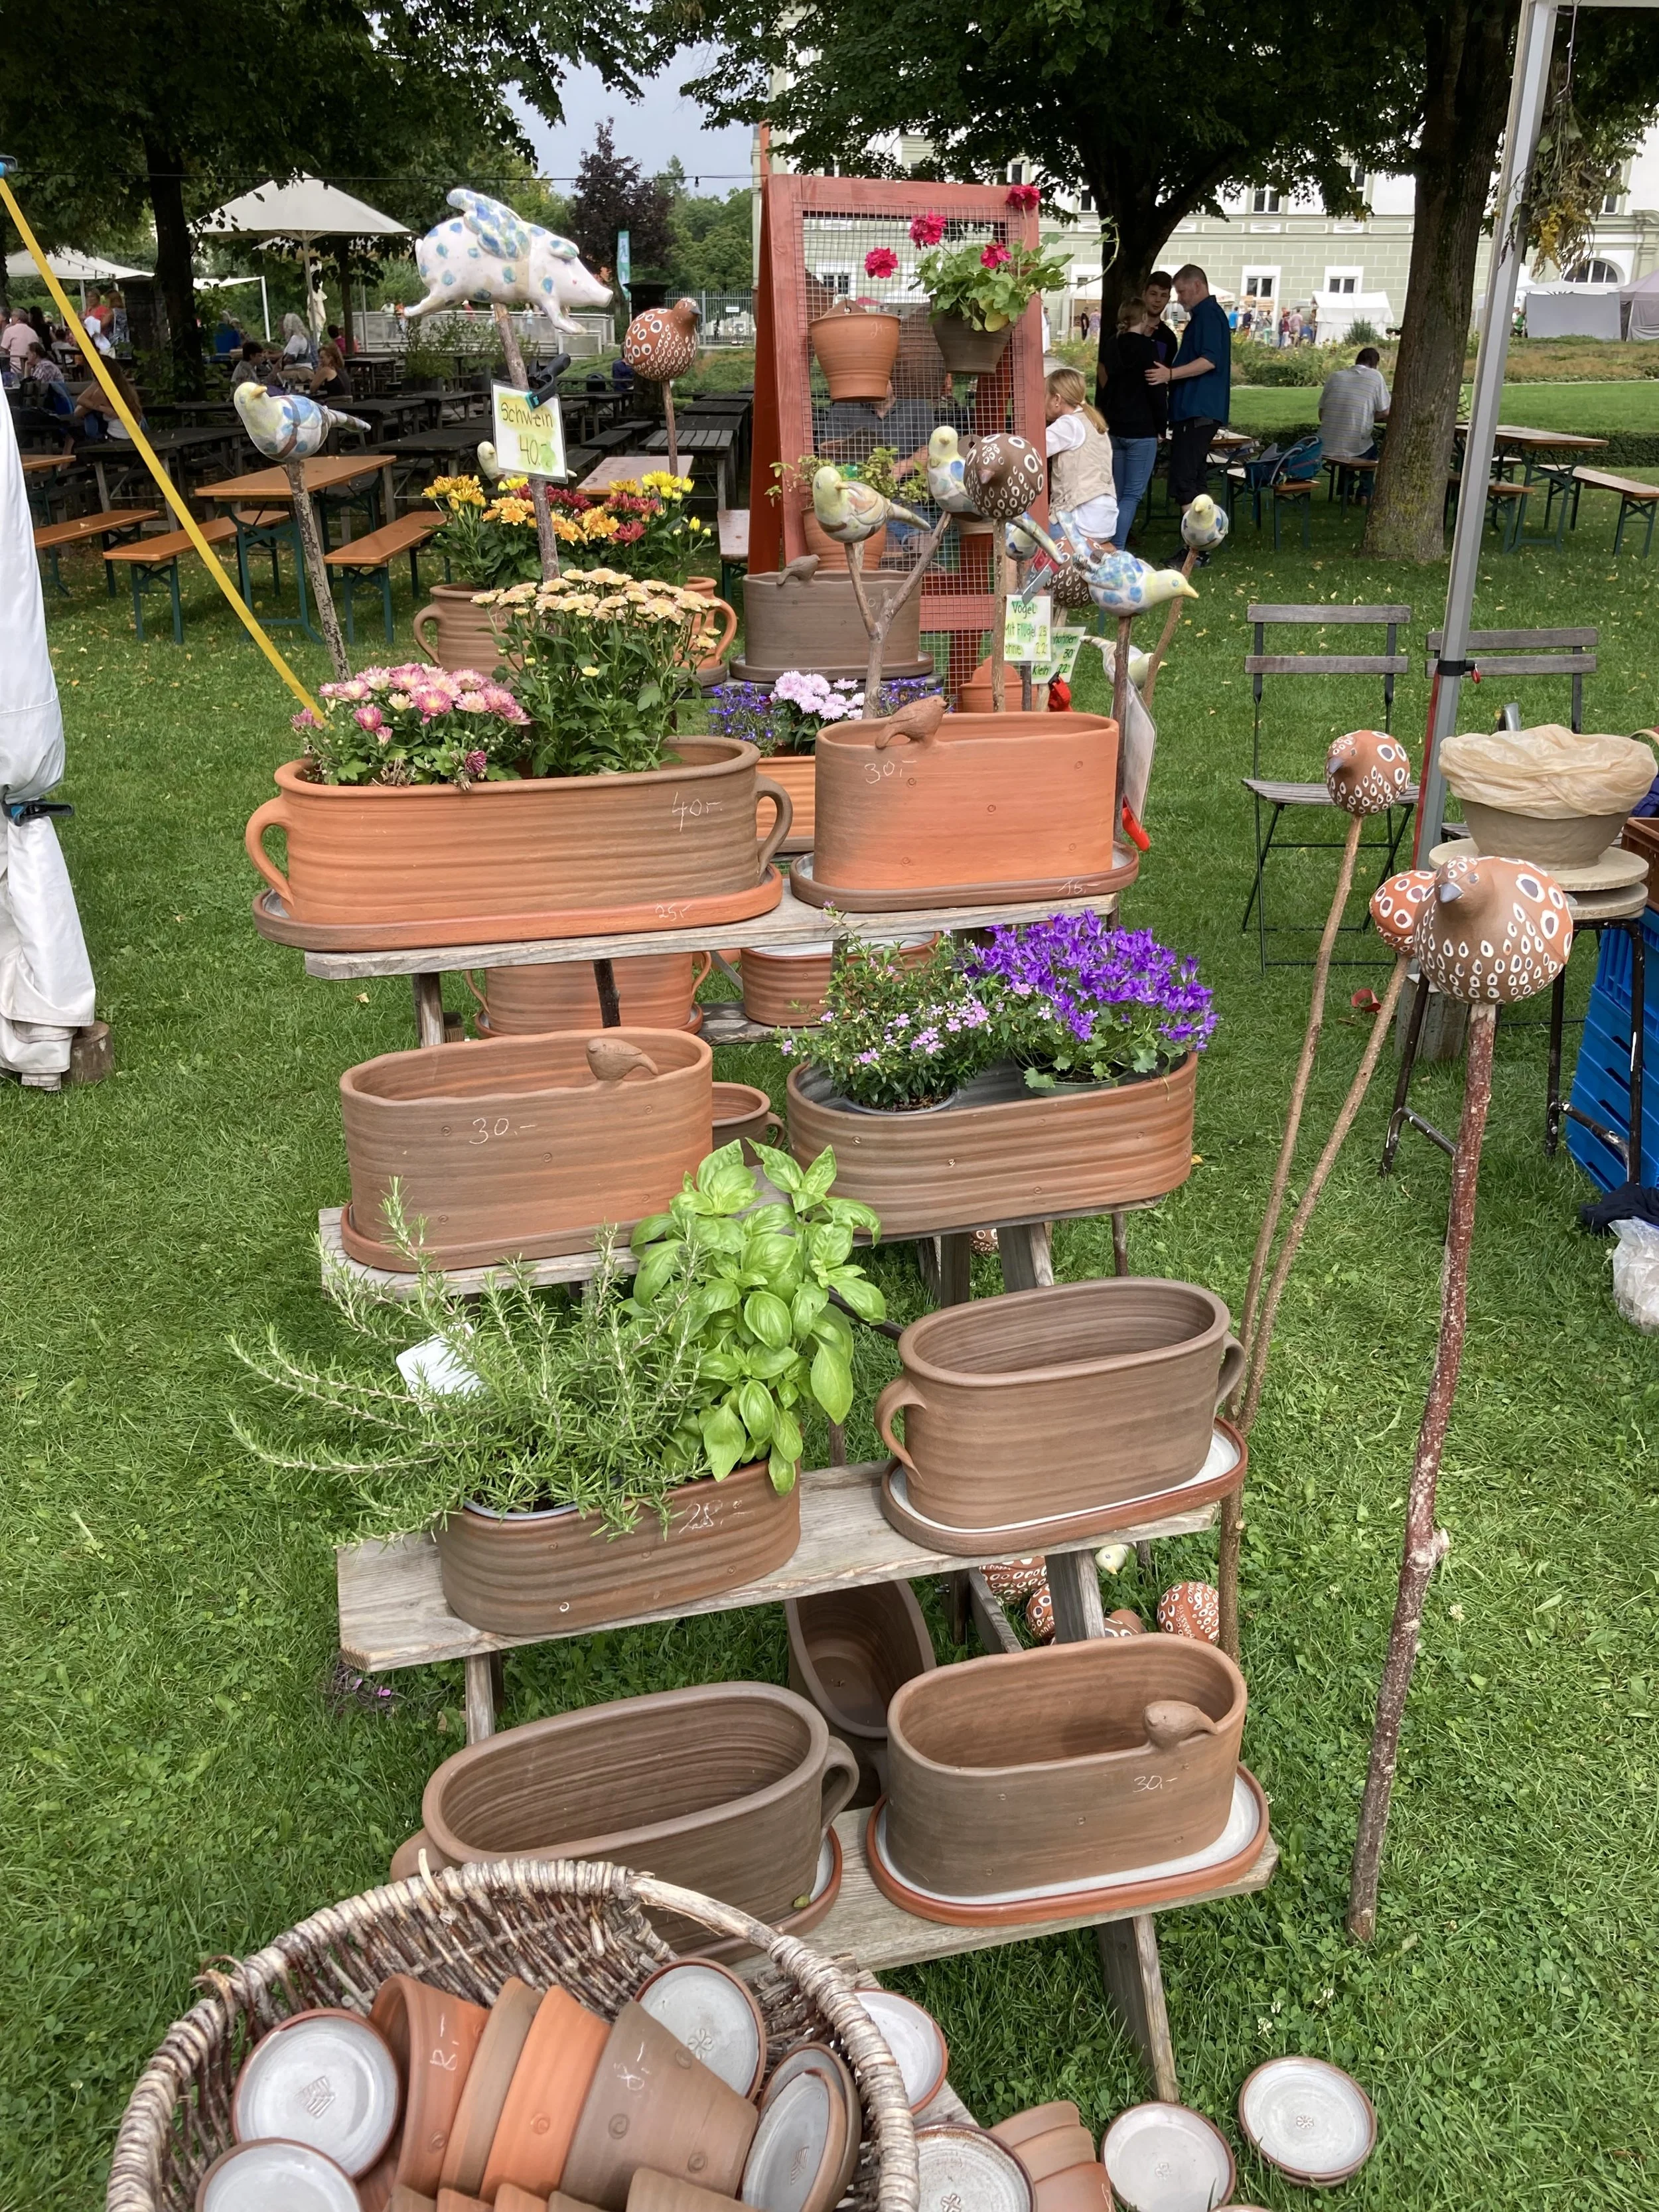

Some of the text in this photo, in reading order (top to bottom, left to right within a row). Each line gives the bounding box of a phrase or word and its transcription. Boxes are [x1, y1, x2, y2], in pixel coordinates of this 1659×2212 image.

[501, 402, 553, 428] Schwein
[1005, 643, 1022, 655] ohne
[1032, 664, 1049, 676] Klein
